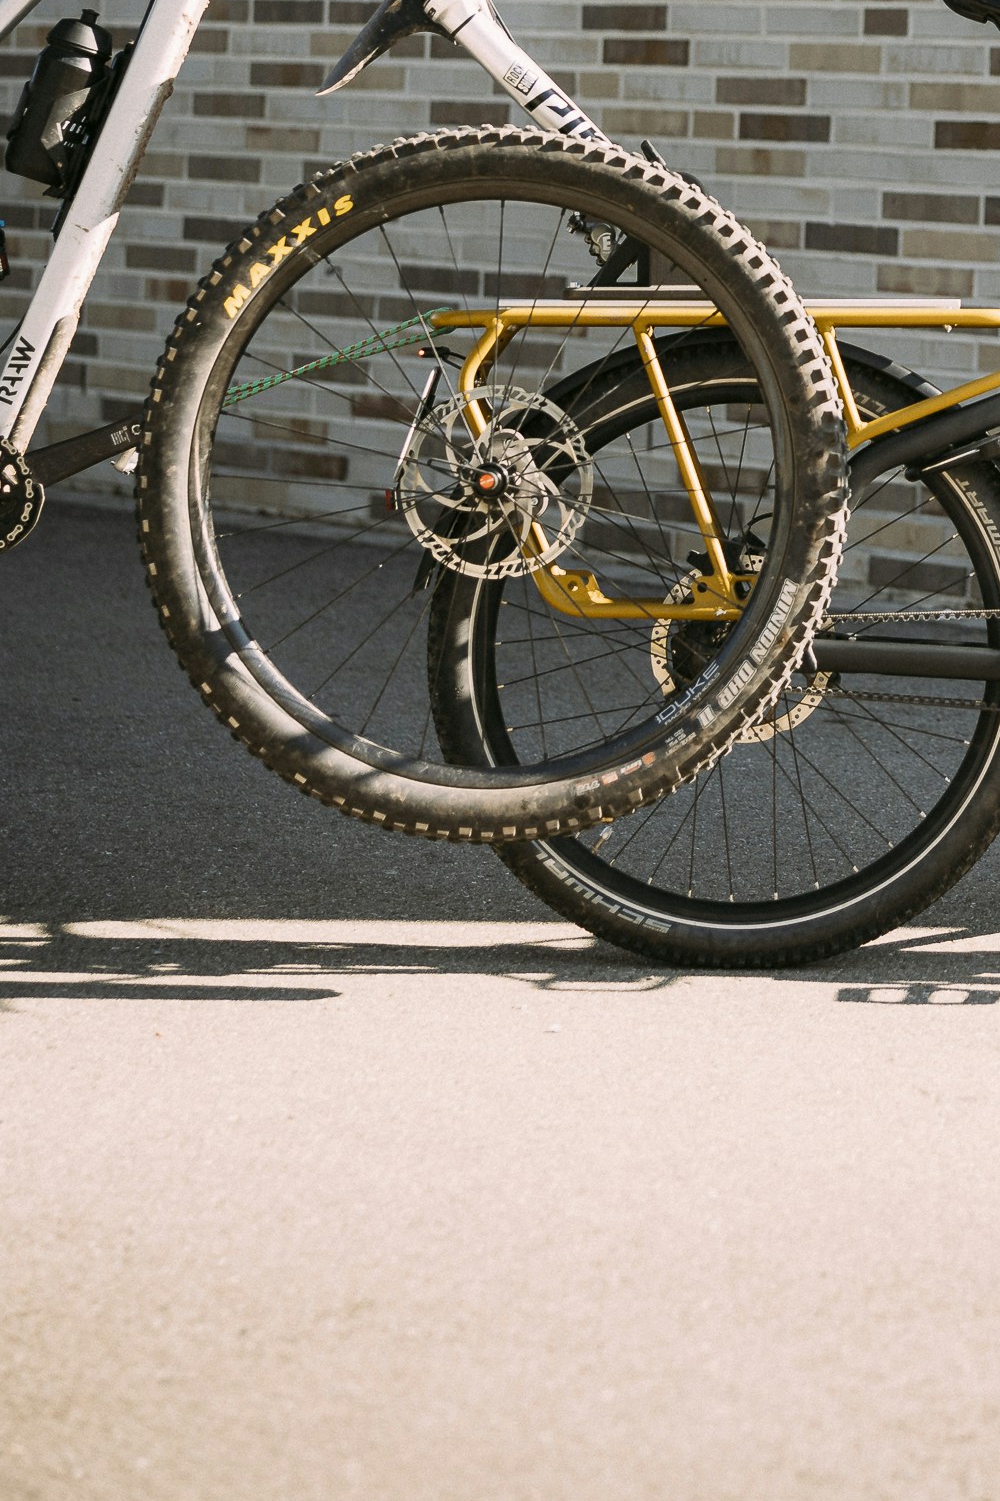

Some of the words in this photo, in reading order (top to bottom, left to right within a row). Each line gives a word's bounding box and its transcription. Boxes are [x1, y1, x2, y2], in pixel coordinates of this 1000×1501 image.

[223, 194, 354, 319] MAXXIS
[750, 578, 800, 665] MINION
[659, 660, 720, 721] DUKE
[716, 660, 758, 710] DHR
[531, 839, 672, 934] SCHWAL
